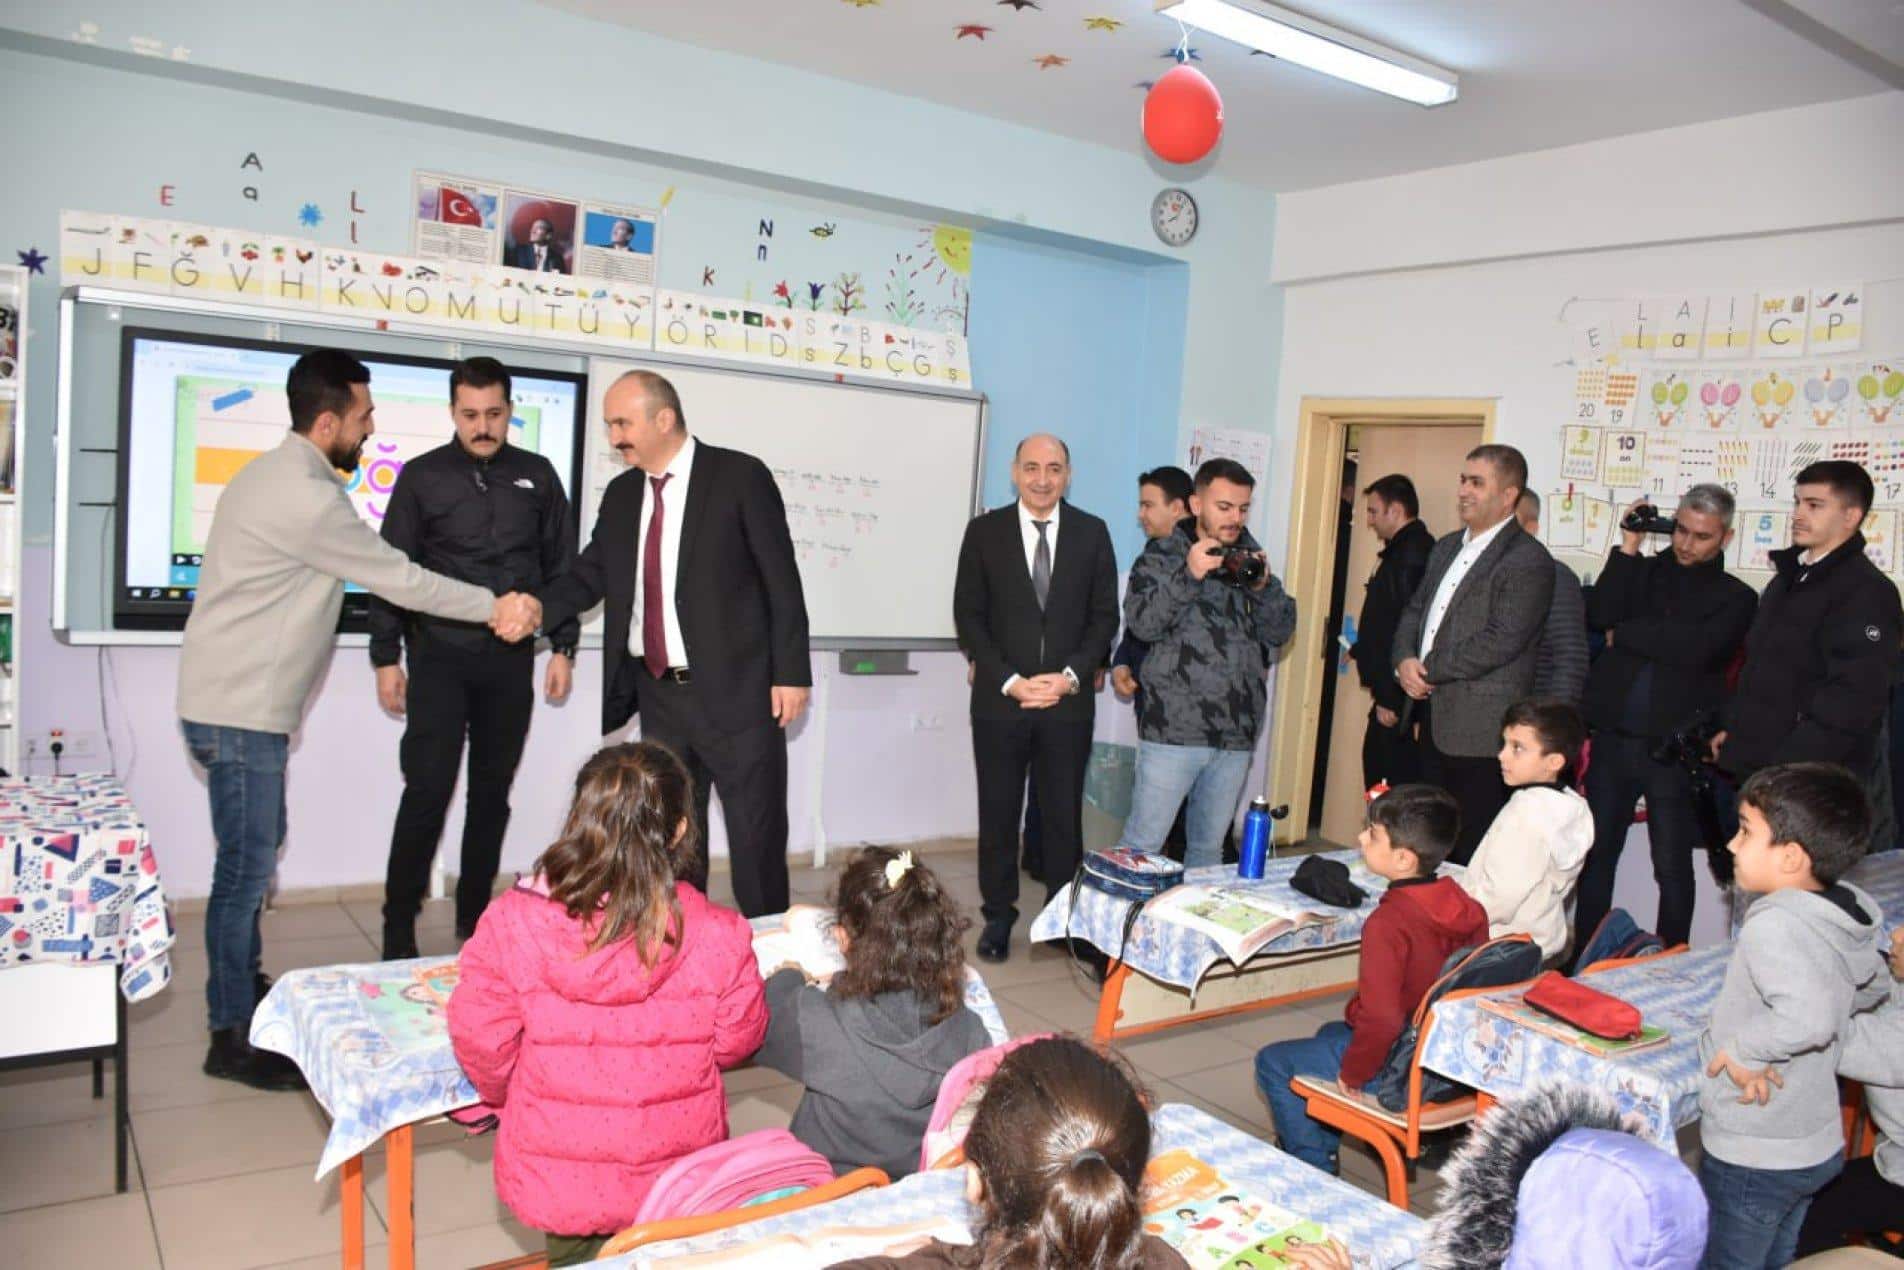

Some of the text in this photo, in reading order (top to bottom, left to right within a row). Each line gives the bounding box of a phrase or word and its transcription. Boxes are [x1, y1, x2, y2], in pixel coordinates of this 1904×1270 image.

[240, 152, 263, 171] A
[159, 184, 176, 206] E
[350, 190, 365, 213] L
[759, 218, 774, 237] N
[757, 244, 768, 261] n
[81, 247, 304, 300] J F Ğ V H
[337, 277, 356, 307] K
[405, 286, 430, 314] O
[447, 291, 476, 320] M
[498, 296, 521, 326] U
[543, 303, 563, 332] T
[578, 303, 600, 335] Ü
[623, 312, 641, 341] Y
[1636, 303, 1648, 321] L
[1674, 300, 1691, 320] A
[1587, 327, 1601, 348] E
[1671, 332, 1686, 348] a
[1768, 318, 1792, 345] C
[1827, 313, 1844, 341] P
[667, 314, 688, 345] Ö
[703, 324, 718, 349] R
[769, 332, 788, 358] D
[832, 341, 849, 367] Z
[912, 353, 931, 377] G
[1579, 403, 1595, 418] 20
[1611, 409, 1624, 425] 19
[1617, 436, 1636, 451] 10
[1885, 483, 1900, 500] 17
